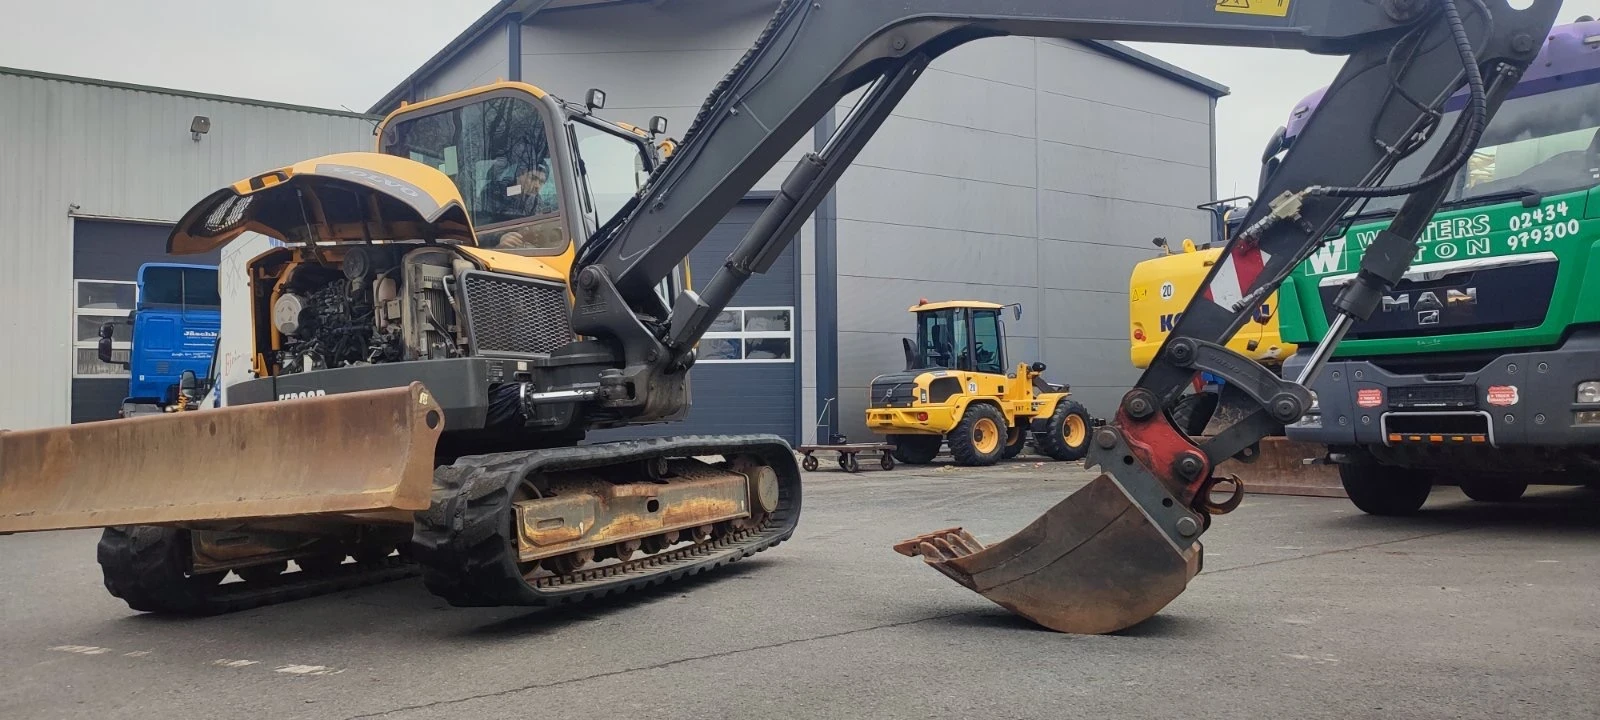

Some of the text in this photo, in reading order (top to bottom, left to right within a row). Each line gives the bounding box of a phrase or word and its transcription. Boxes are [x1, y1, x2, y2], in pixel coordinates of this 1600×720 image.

[333, 166, 418, 197] VOLVO
[1509, 201, 1569, 232] 02434
[1357, 214, 1491, 251] WTERS
[1507, 219, 1580, 251] 979300
[1309, 236, 1347, 274] W
[1360, 238, 1491, 264] TON
[1162, 284, 1172, 298] 20
[1382, 287, 1477, 312] MAN
